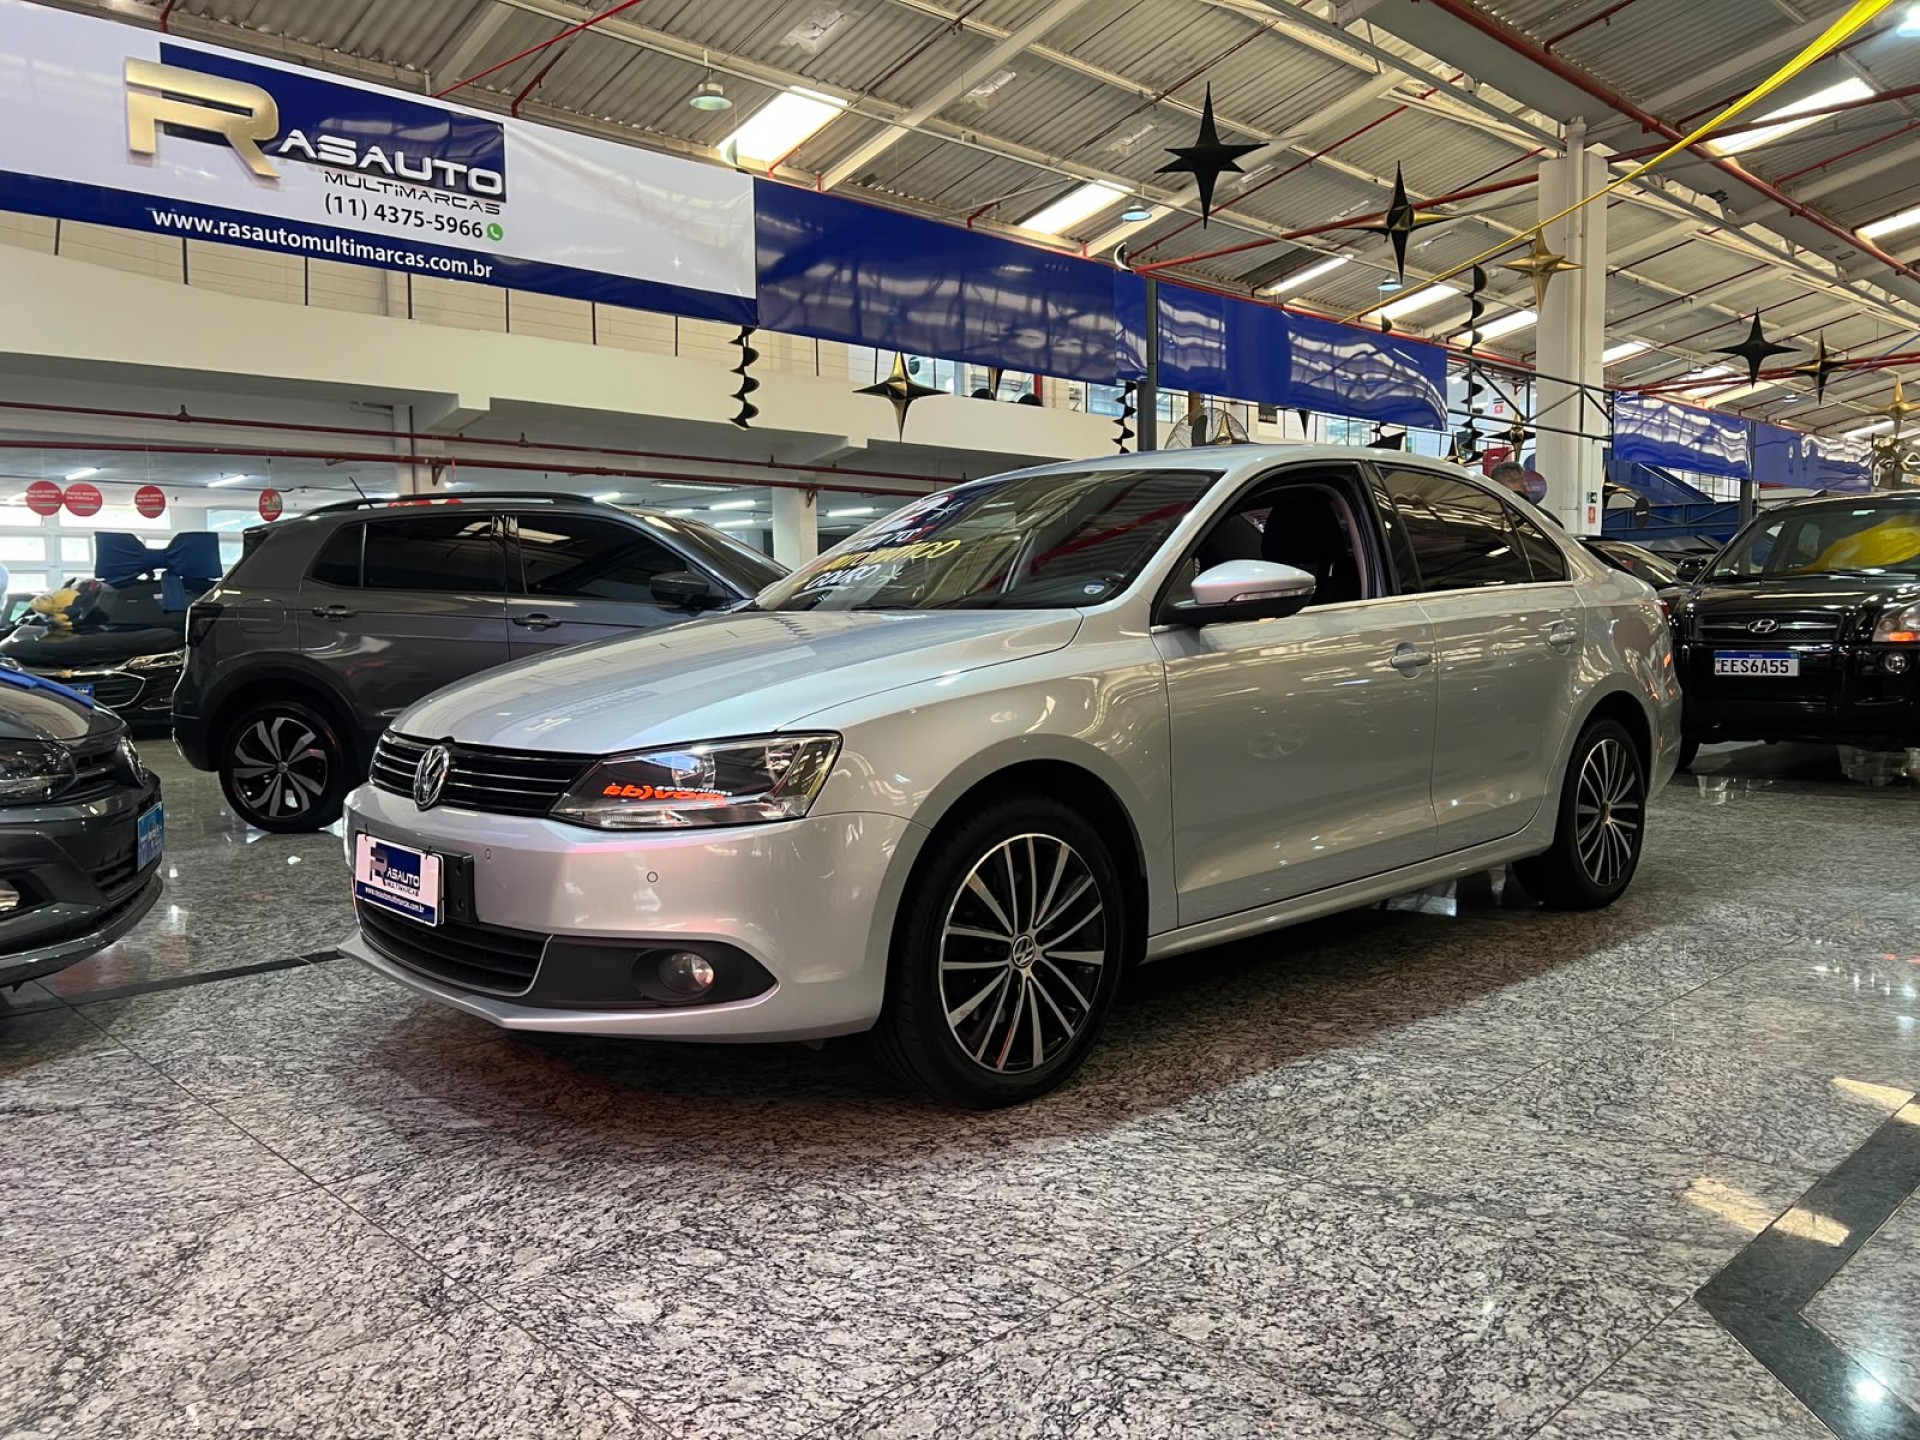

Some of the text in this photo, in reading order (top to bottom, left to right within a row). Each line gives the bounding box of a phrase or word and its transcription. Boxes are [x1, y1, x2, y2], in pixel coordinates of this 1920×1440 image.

[324, 192, 484, 239] (11) 4375-5966
[151, 208, 494, 279] www.rasautomultimarcas.com.br
[1721, 659, 1789, 674] EES6A55
